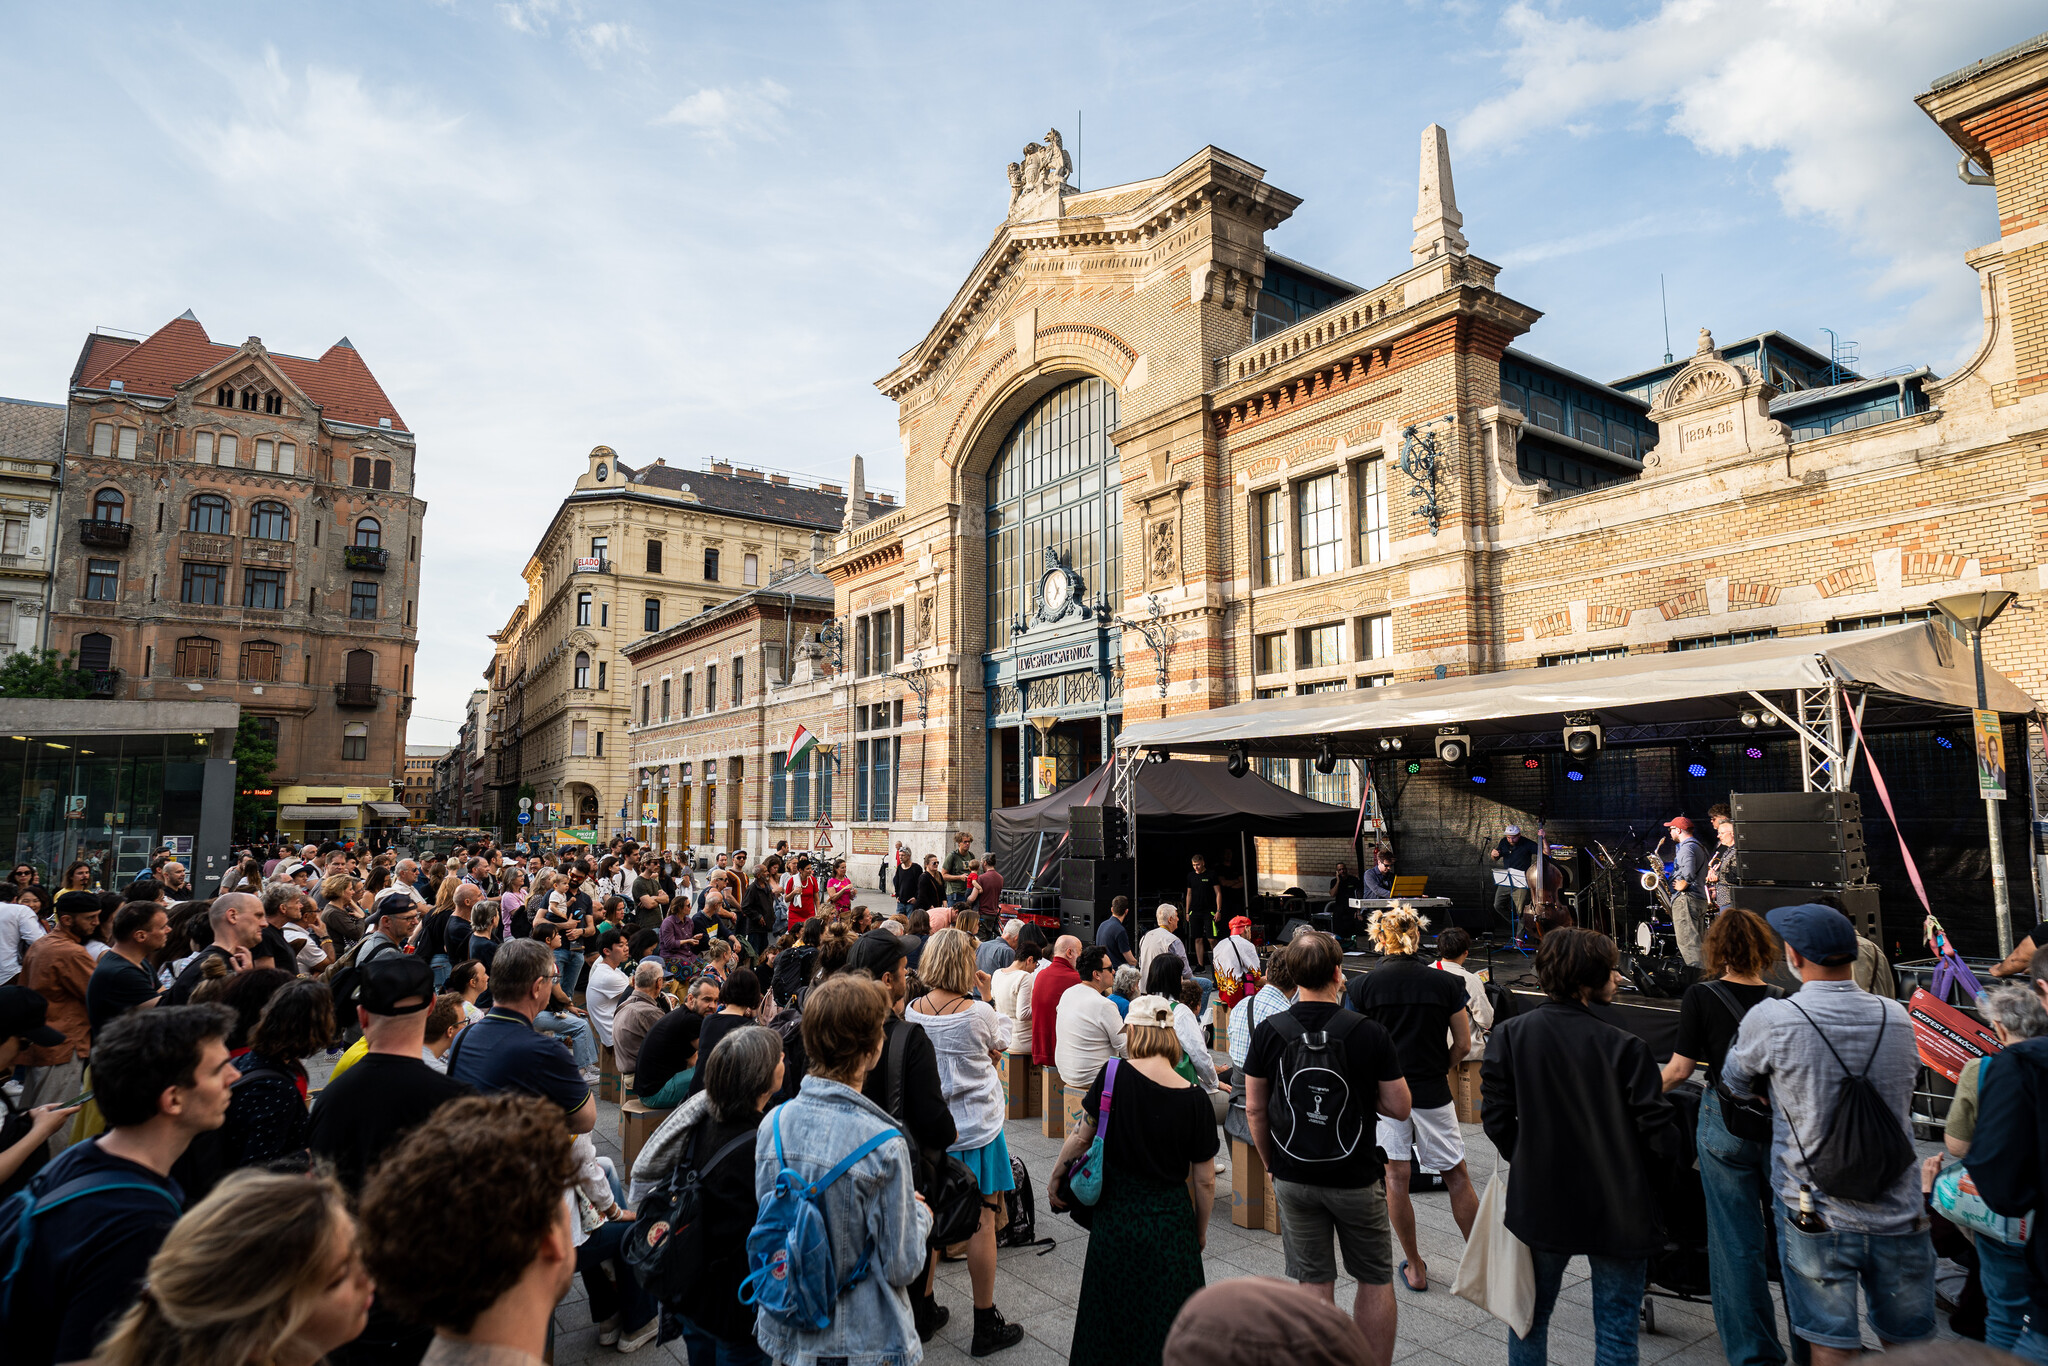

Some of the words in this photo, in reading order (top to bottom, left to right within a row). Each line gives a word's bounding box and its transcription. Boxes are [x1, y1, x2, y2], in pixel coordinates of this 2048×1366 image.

[1685, 420, 1733, 443] 1894-96
[1912, 1009, 1945, 1031] JAZZFEST
[1949, 1032, 1983, 1056] RÁKÓCZIN
